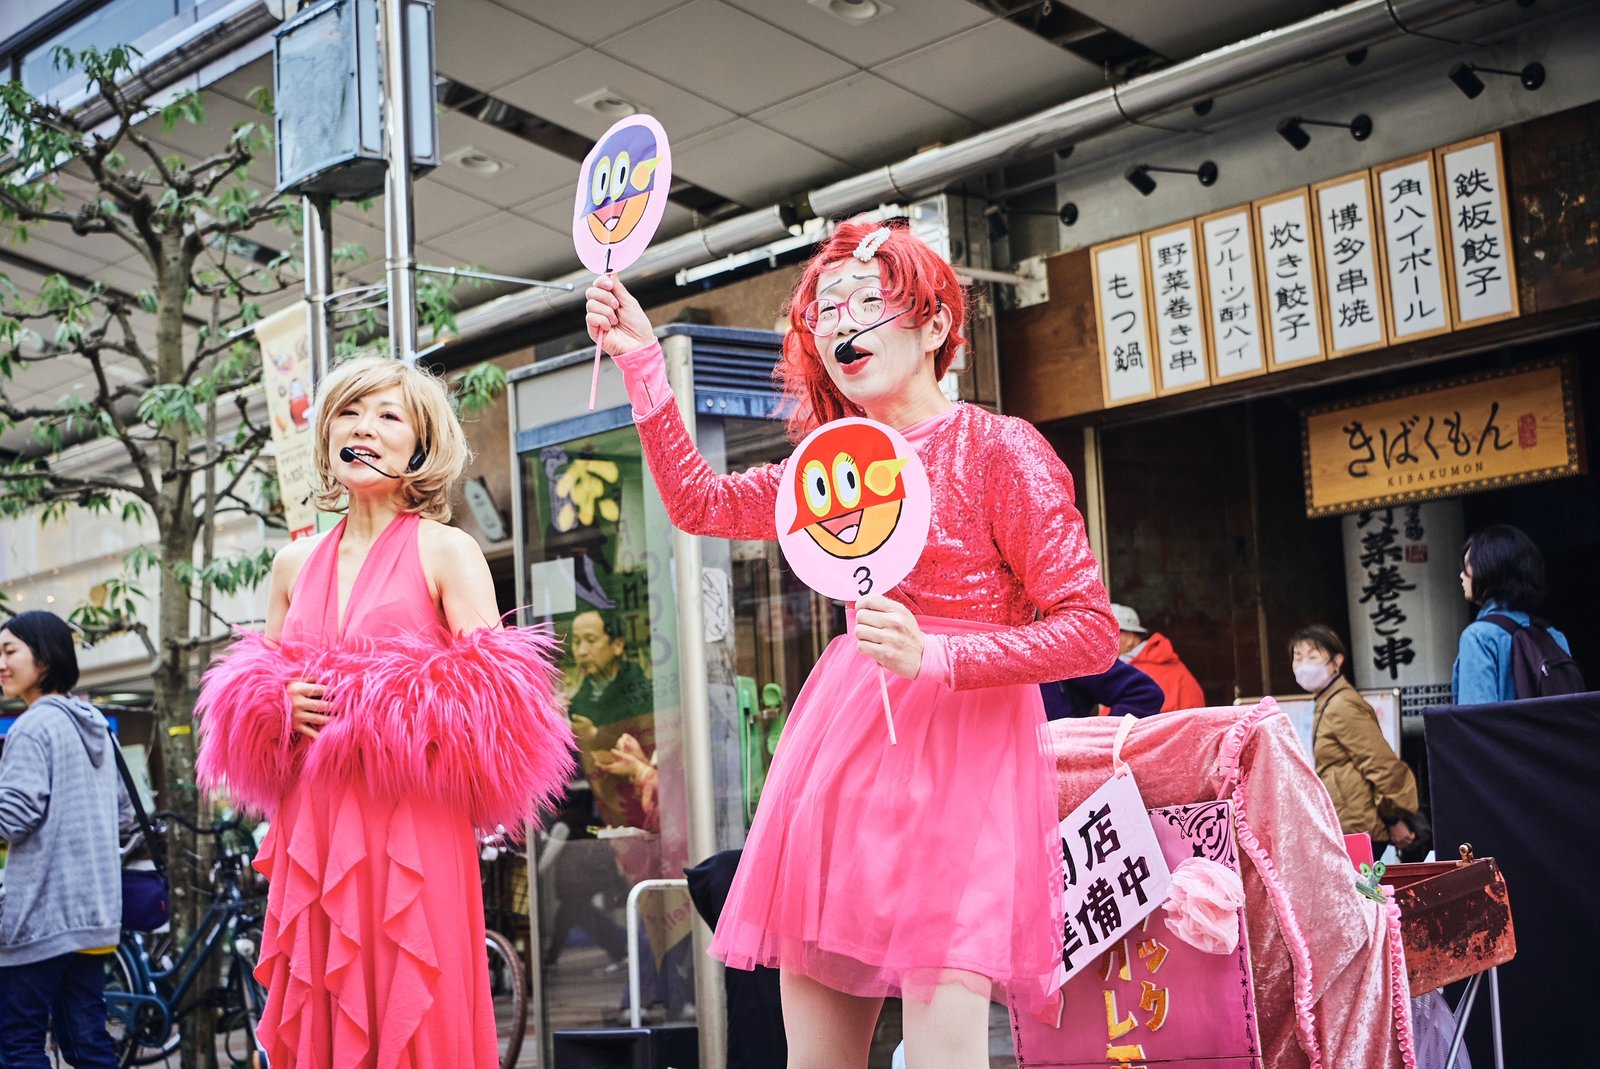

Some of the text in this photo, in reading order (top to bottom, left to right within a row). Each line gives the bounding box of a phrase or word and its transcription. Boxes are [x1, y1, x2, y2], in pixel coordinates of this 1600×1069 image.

[1214, 227, 1252, 359] フルーツ酎ハイ
[1268, 220, 1310, 341] 炊き餃子
[1328, 202, 1374, 328] 博多串焼
[1390, 178, 1437, 322] 角ハイボール
[1453, 168, 1502, 297] 鉄板餃子
[1108, 273, 1144, 372] もつ鍋
[1157, 242, 1197, 371] 野菜巻き串
[1342, 402, 1514, 479] きばくもん
[1387, 461, 1484, 488] KIBAKUMON
[853, 566, 874, 596] 3
